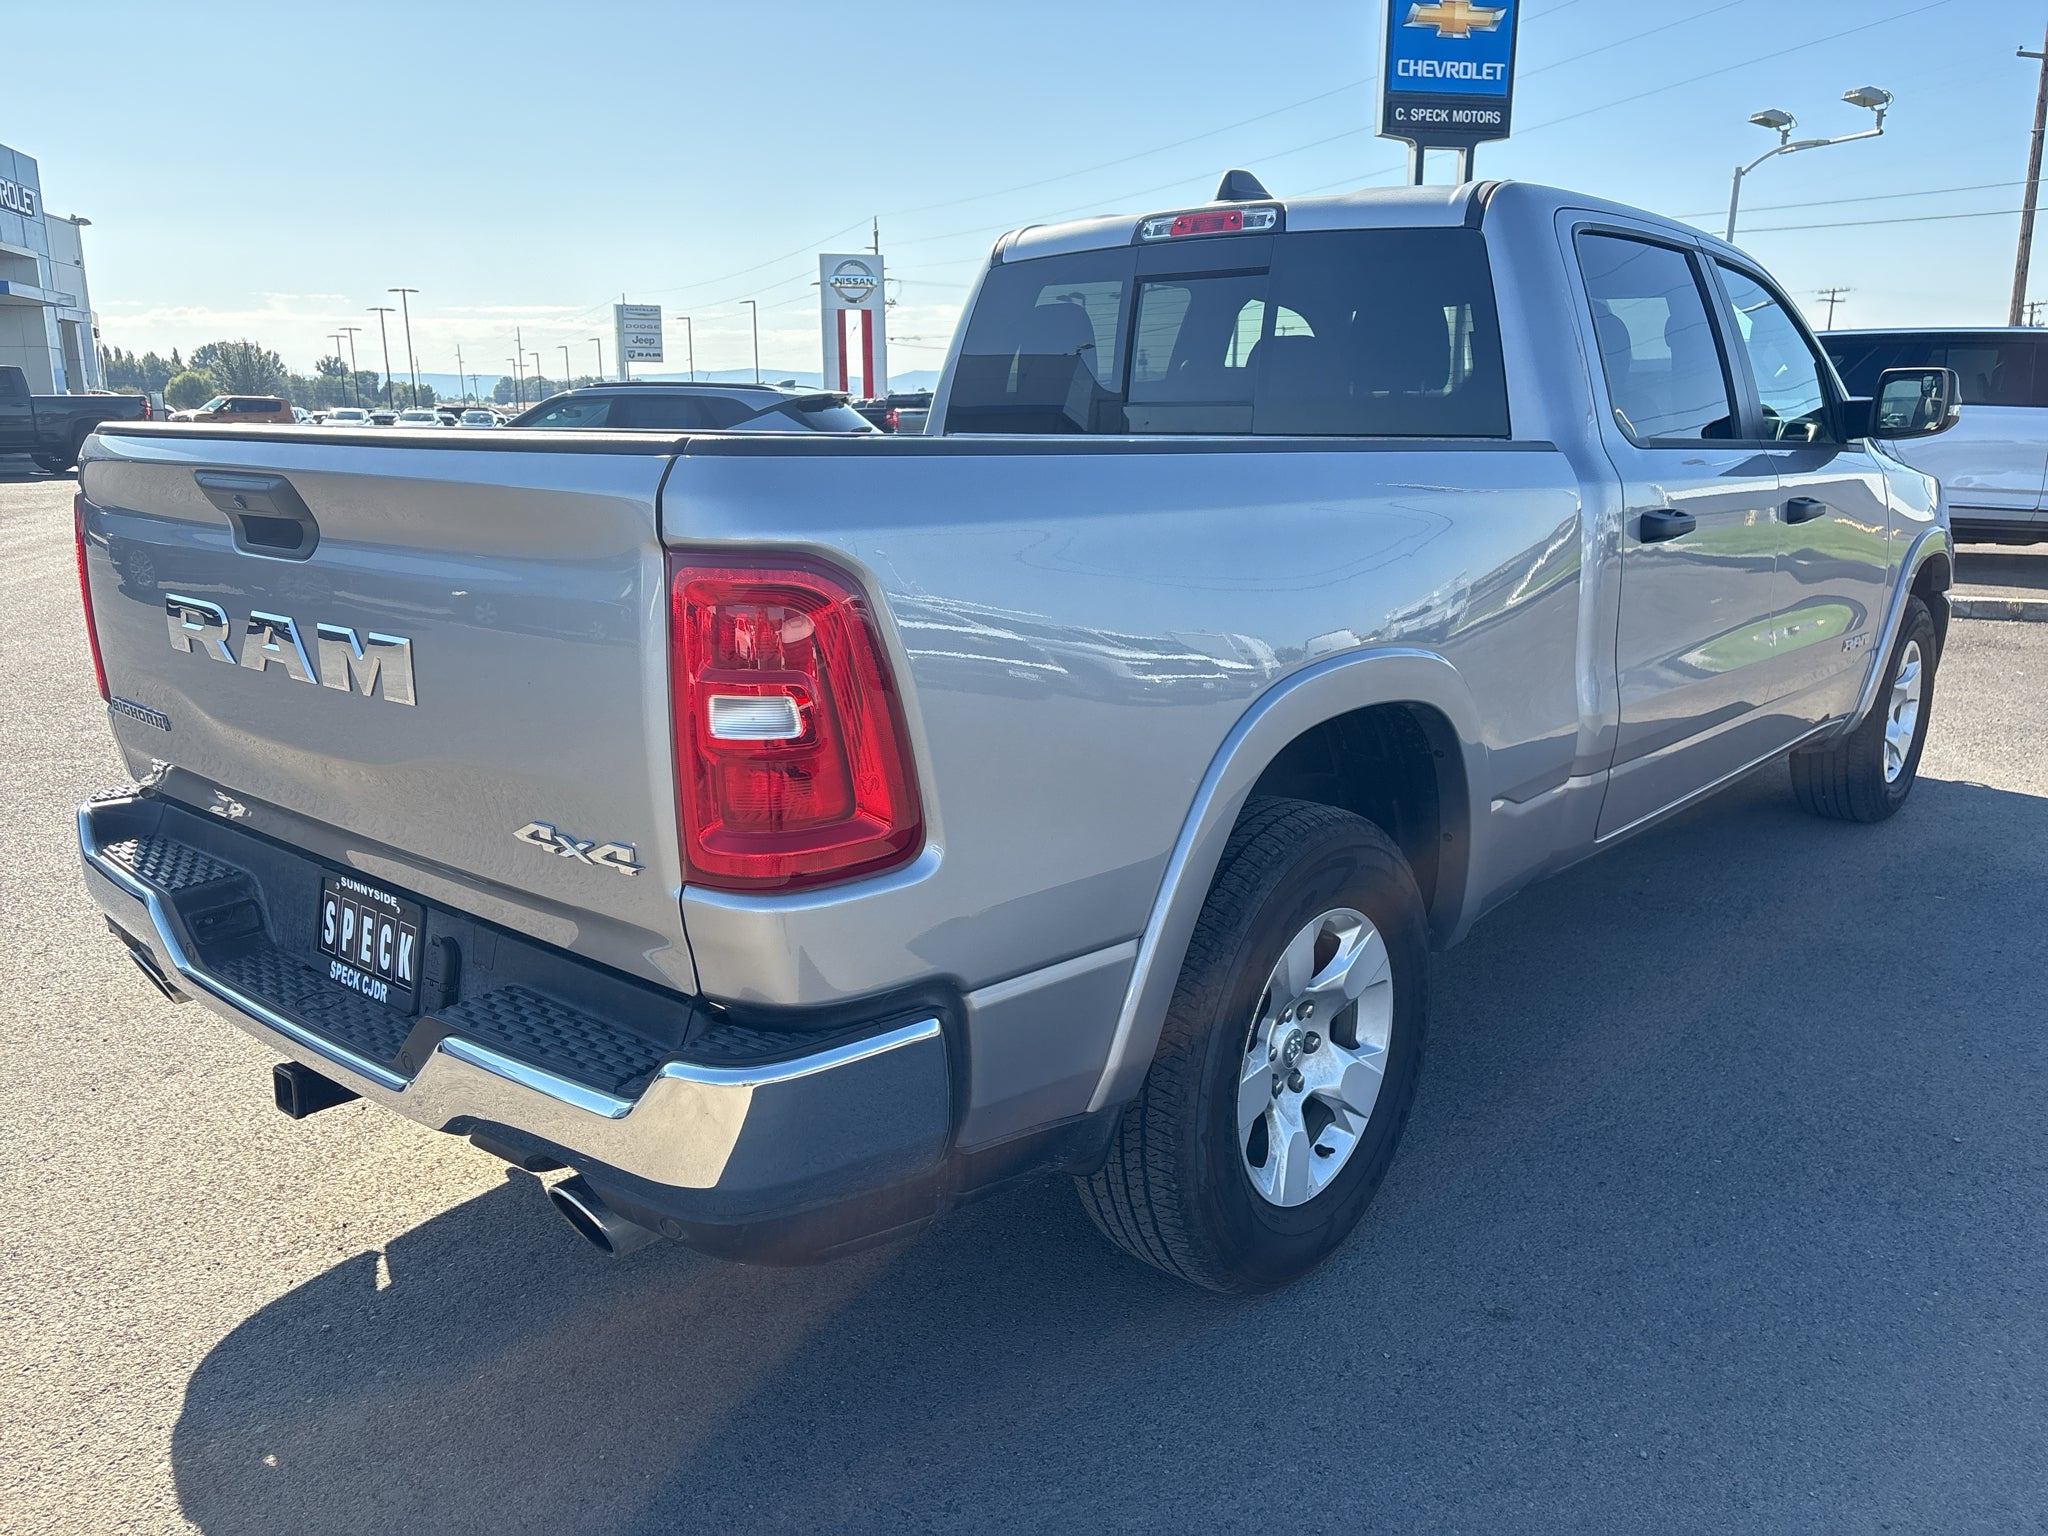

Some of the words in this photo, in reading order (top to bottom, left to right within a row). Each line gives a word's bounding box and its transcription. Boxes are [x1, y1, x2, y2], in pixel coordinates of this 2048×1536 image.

[1397, 59, 1505, 80] CHEVROLET
[1395, 107, 1407, 120] C.
[1410, 108, 1449, 122] SPECK
[1452, 110, 1501, 124] MOTORS
[834, 277, 874, 285] NISSAN
[631, 335, 655, 346] Jeep
[165, 592, 417, 707] RAM
[111, 698, 168, 731] BIGHORN
[324, 900, 414, 981] SPECK
[329, 960, 361, 991] SPECK
[361, 975, 388, 1004] CJDR
